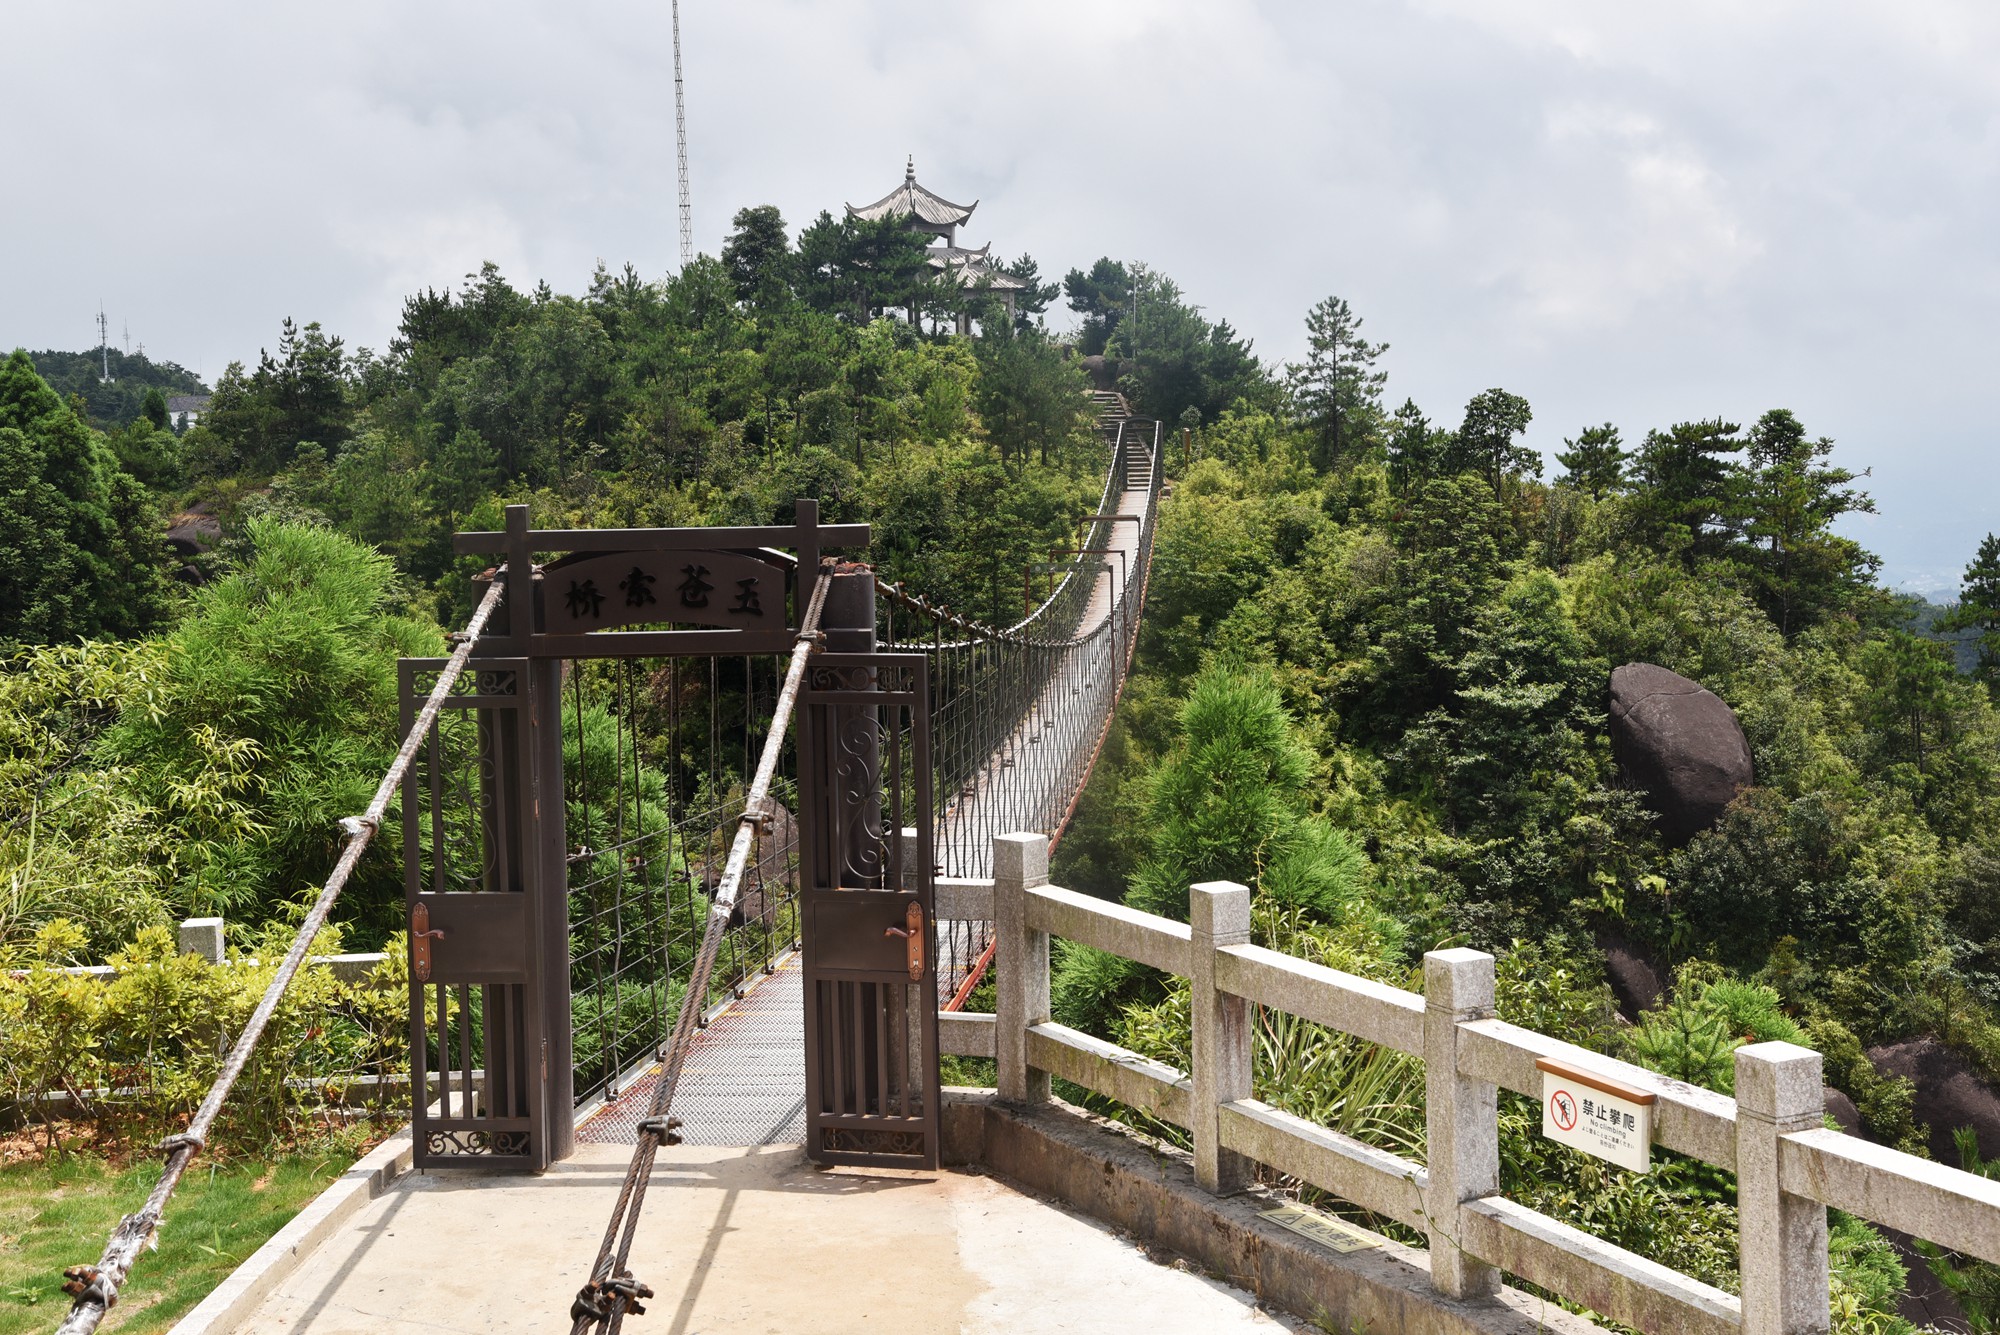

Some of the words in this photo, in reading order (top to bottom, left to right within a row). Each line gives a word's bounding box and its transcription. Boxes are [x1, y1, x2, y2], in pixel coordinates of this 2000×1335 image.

[1582, 1098, 1635, 1132] 禁止攀爬
[1590, 1119, 1598, 1128] No
[1600, 1123, 1626, 1139] climbing
